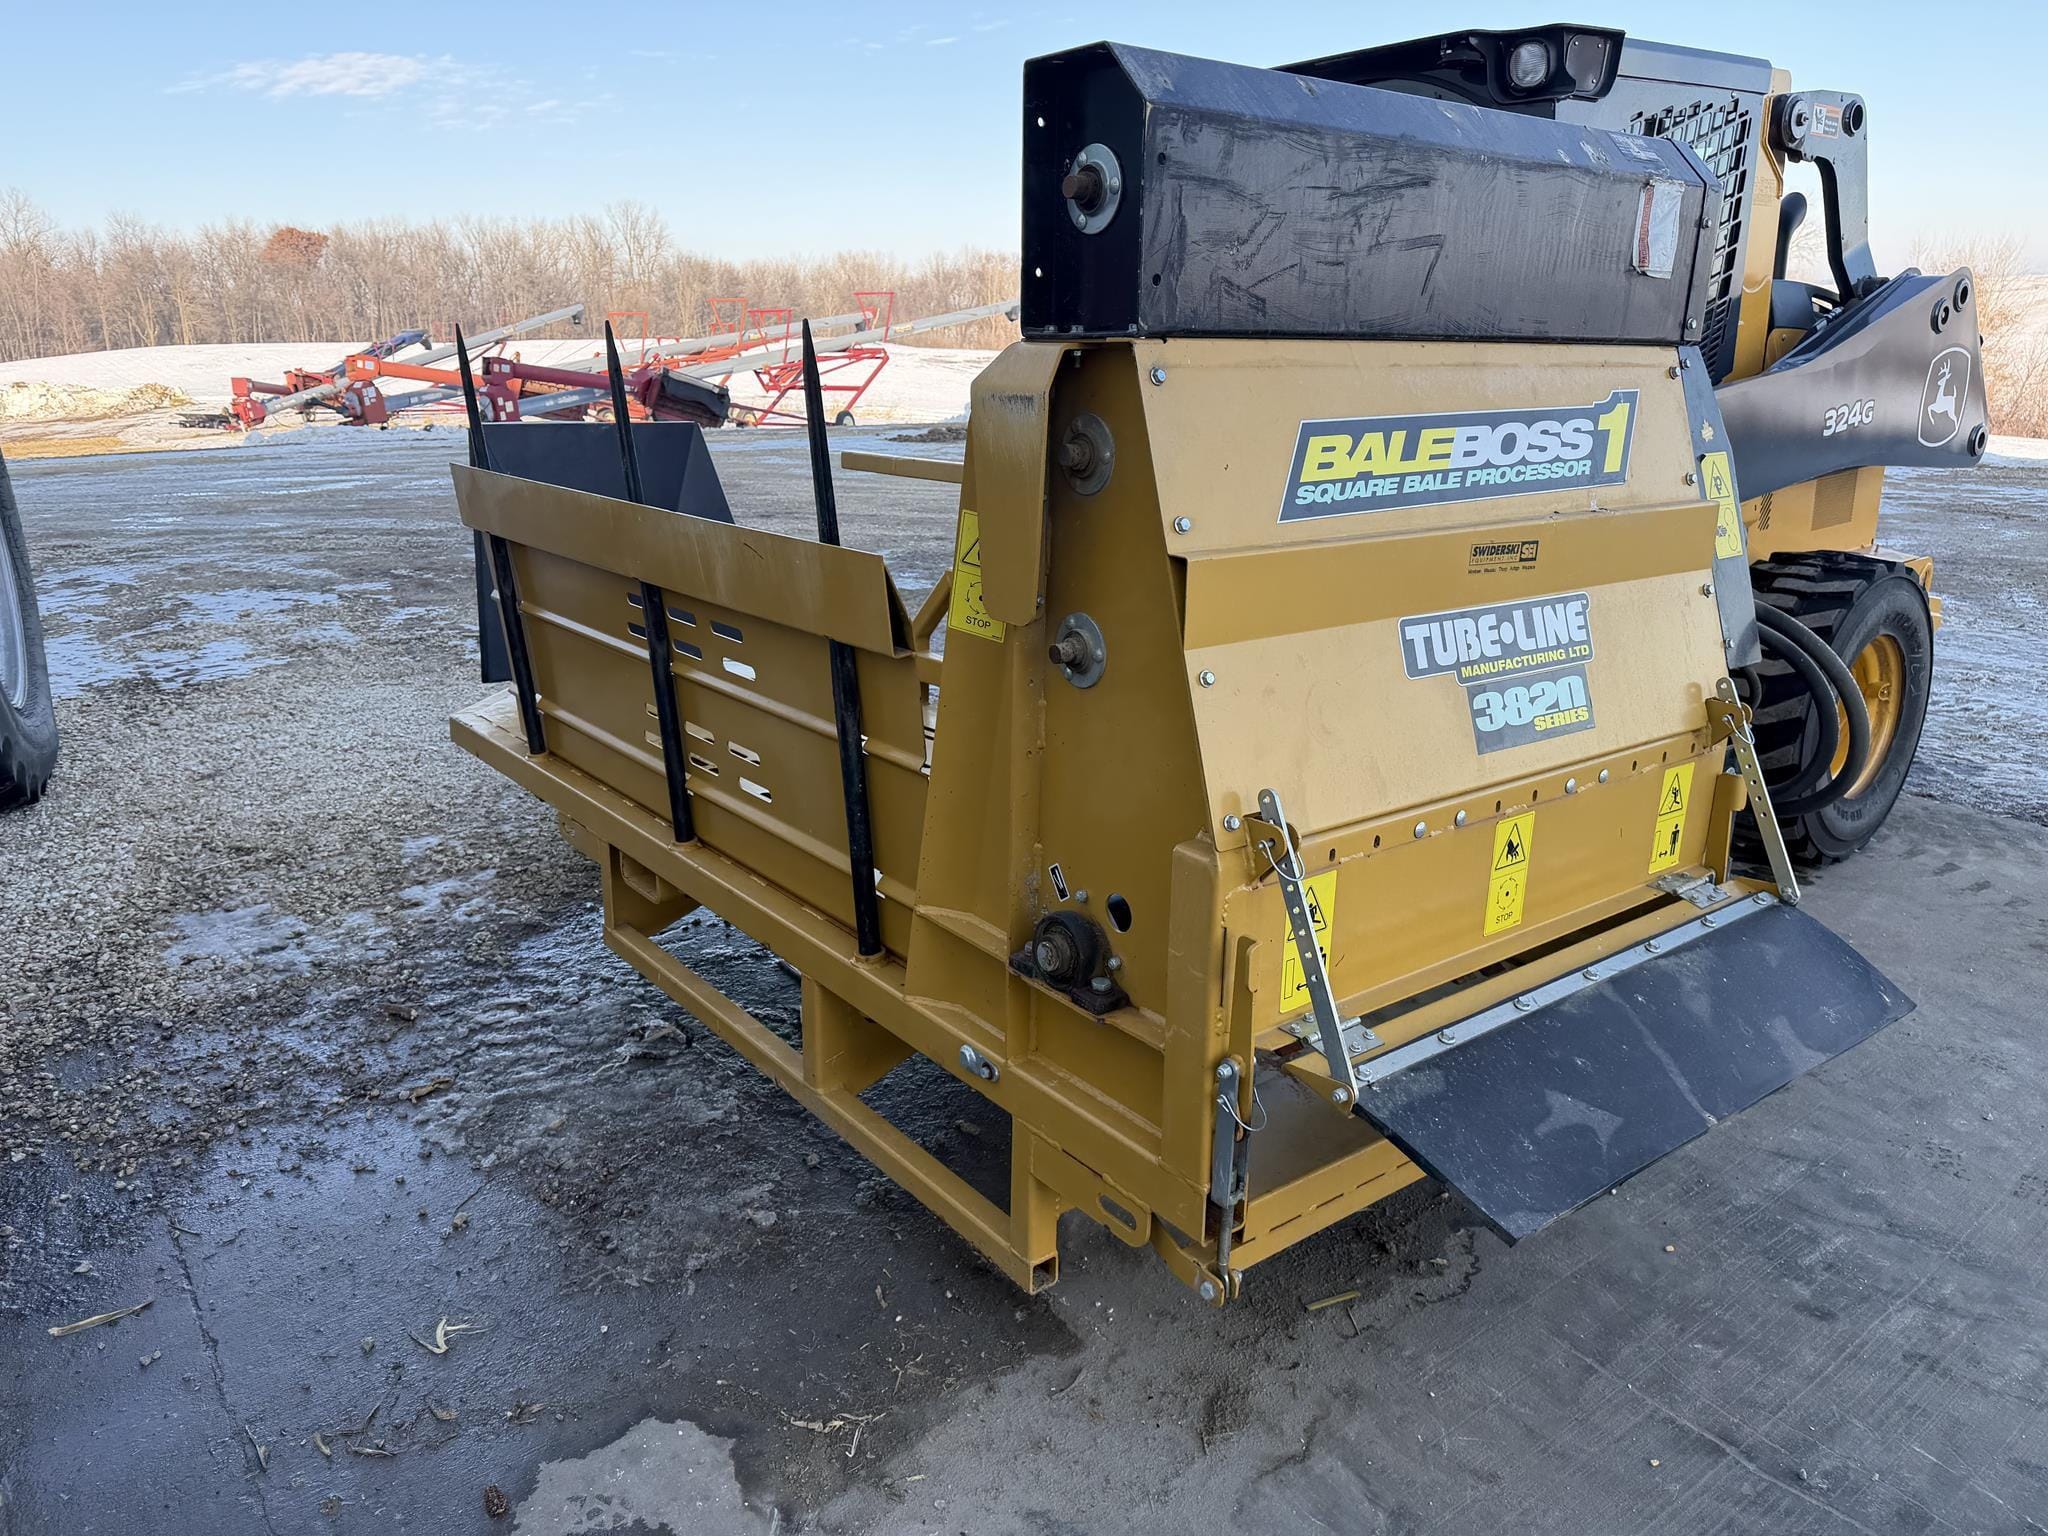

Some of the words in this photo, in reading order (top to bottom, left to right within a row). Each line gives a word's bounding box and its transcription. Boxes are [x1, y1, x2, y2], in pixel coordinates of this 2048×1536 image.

[1823, 400, 1875, 437] 324G
[1299, 417, 1593, 483] BALEBOSS
[1597, 402, 1629, 474] 1
[1295, 480, 1398, 505] SQUARE
[1402, 471, 1461, 494] BALE
[1465, 459, 1591, 488] PROCESSOR
[1472, 543, 1520, 557] SWIDERSKI
[965, 615, 991, 629] STOP
[1460, 649, 1566, 678] MANUFACTURING
[1568, 644, 1590, 658] LTD
[1533, 706, 1589, 732] SERIES
[1495, 911, 1513, 924] STOP
